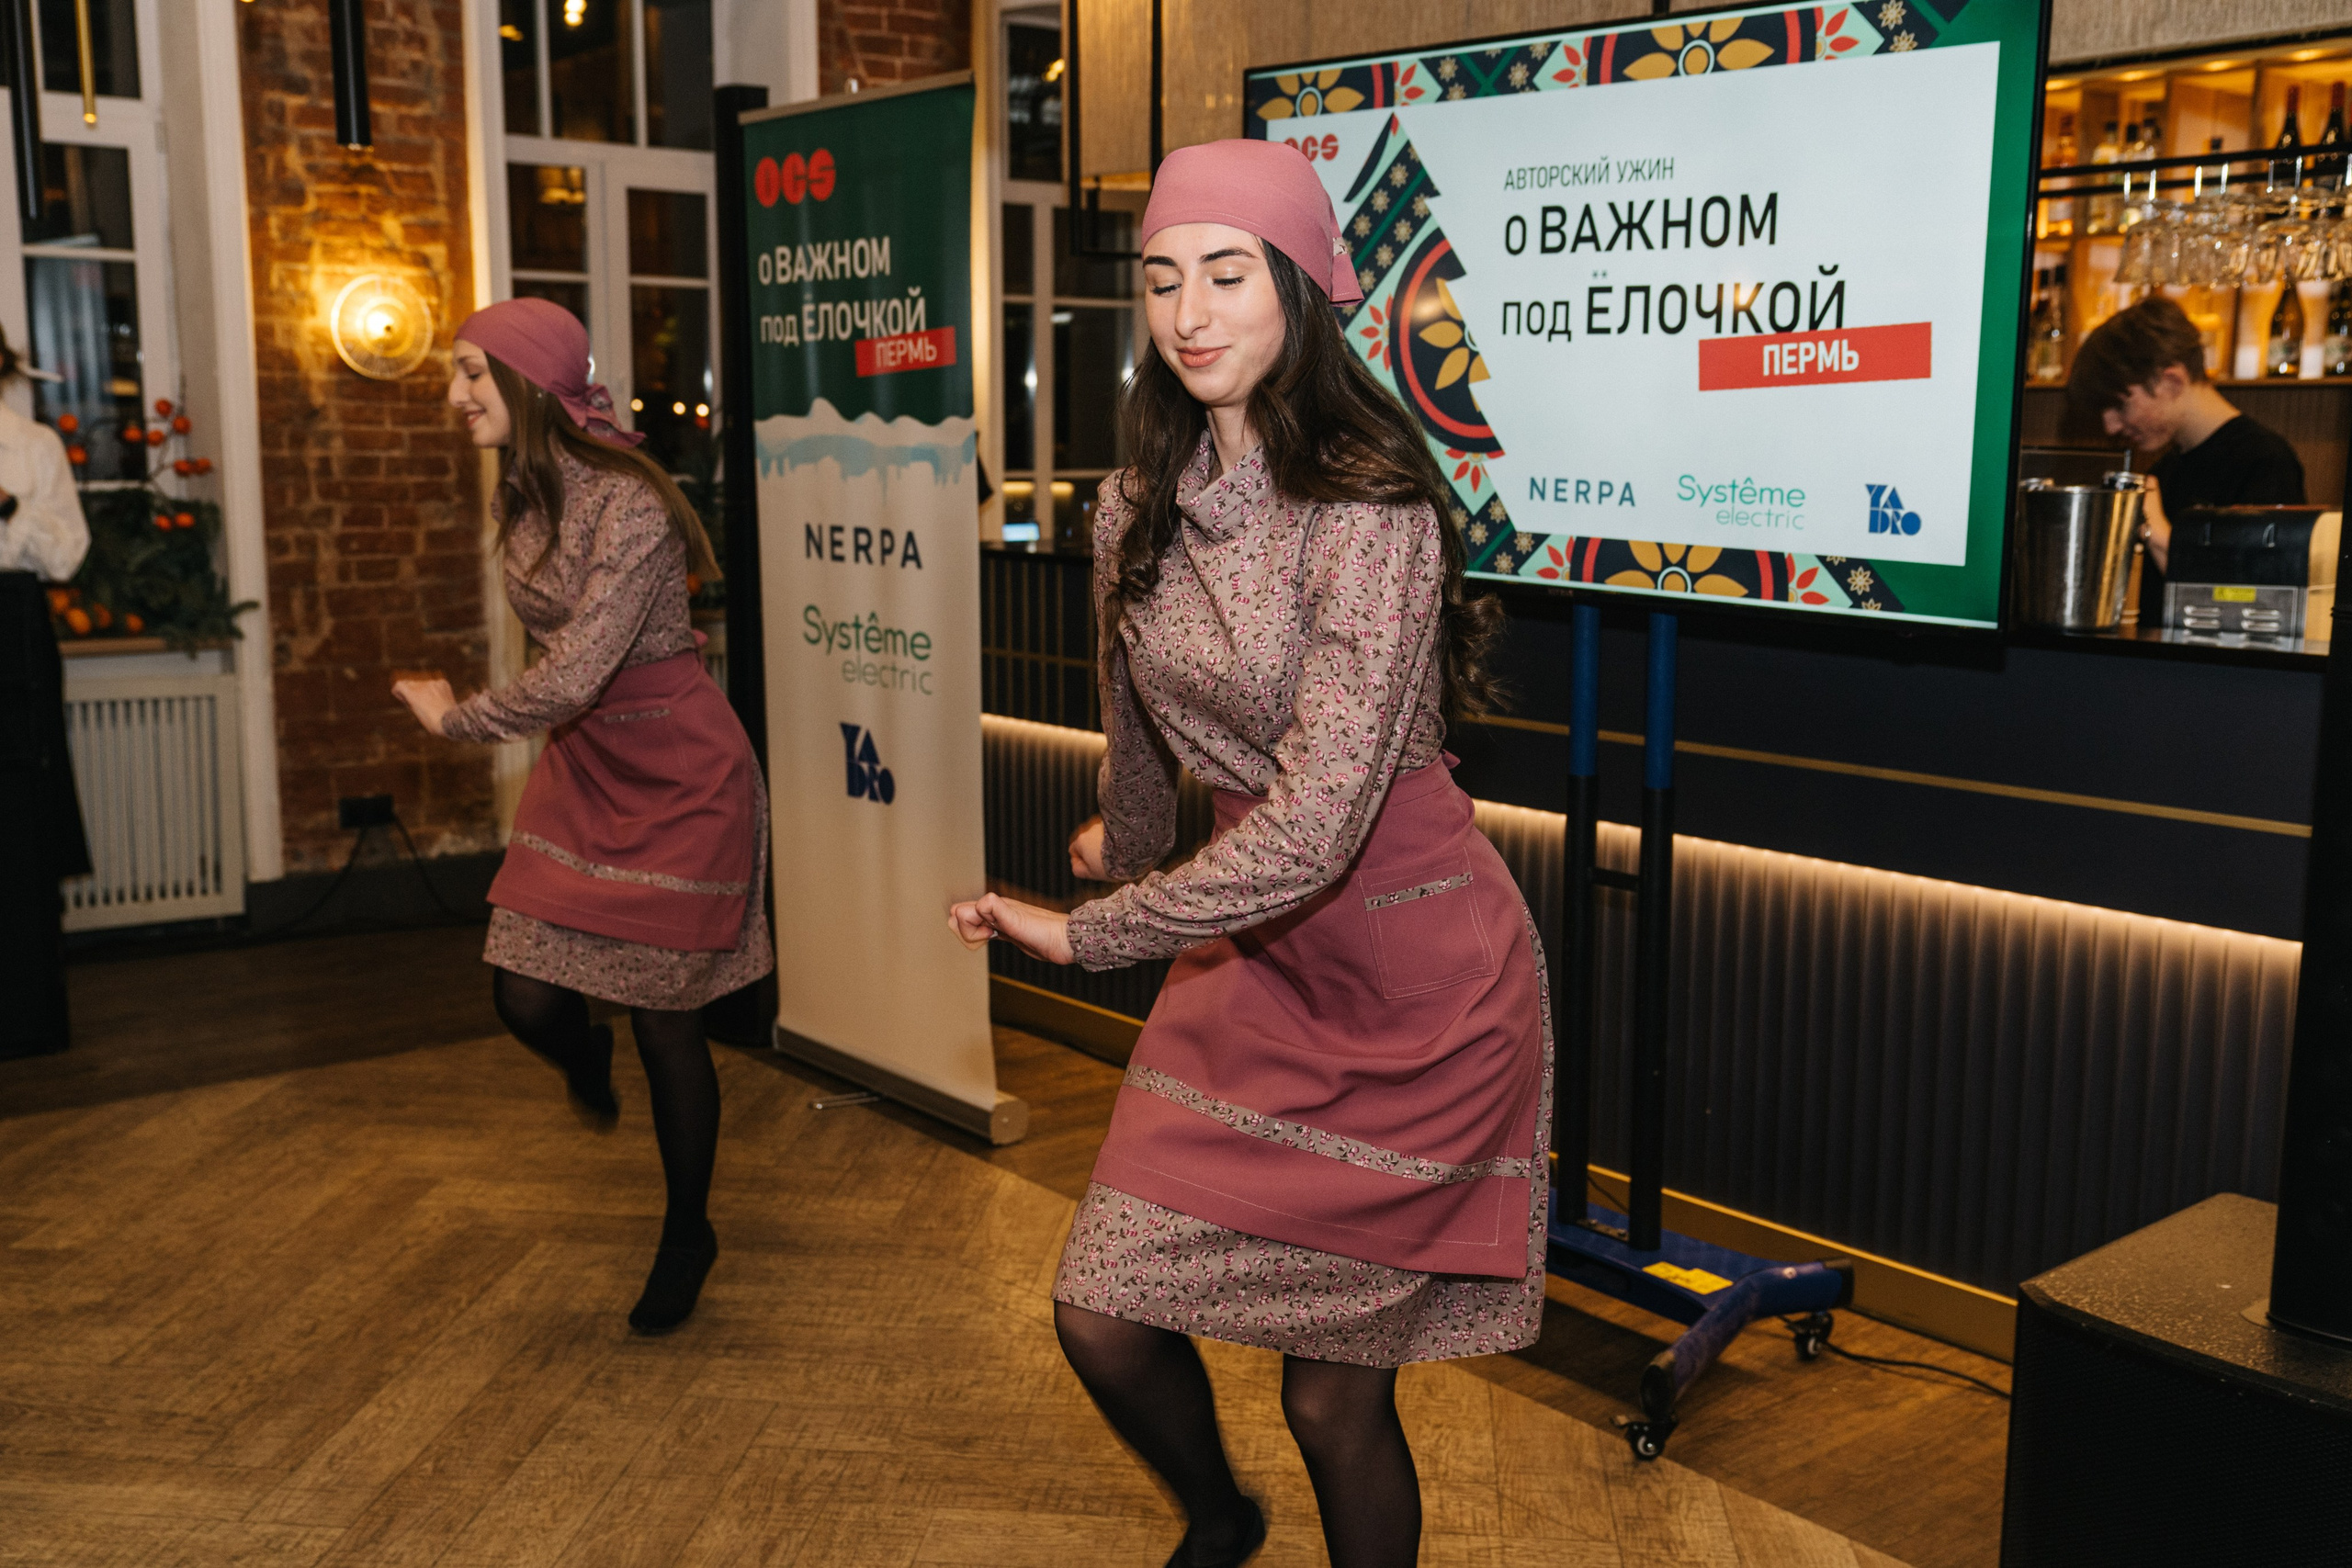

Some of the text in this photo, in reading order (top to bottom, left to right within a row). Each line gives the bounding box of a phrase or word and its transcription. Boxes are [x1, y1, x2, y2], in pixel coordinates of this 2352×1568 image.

[754, 148, 837, 209] OCS
[1504, 155, 1675, 191] АВТОРСКИЙ УЖИН
[1540, 192, 1779, 254] ВАЖНОМ
[775, 236, 890, 285] ВАЖНОМ
[760, 286, 927, 347] под ЁЛОЧКОЙ
[1501, 264, 1847, 343] под ЁЛОЧКОЙ
[875, 336, 937, 367] ПЕРМЬ
[1762, 338, 1860, 378] ПЕРМЬ
[1529, 476, 1636, 508] NERPA
[1676, 474, 1806, 509] Systême
[1715, 506, 1805, 531] electric
[804, 523, 922, 570] NERPA
[802, 604, 933, 661] Systême
[841, 654, 933, 695] electric
